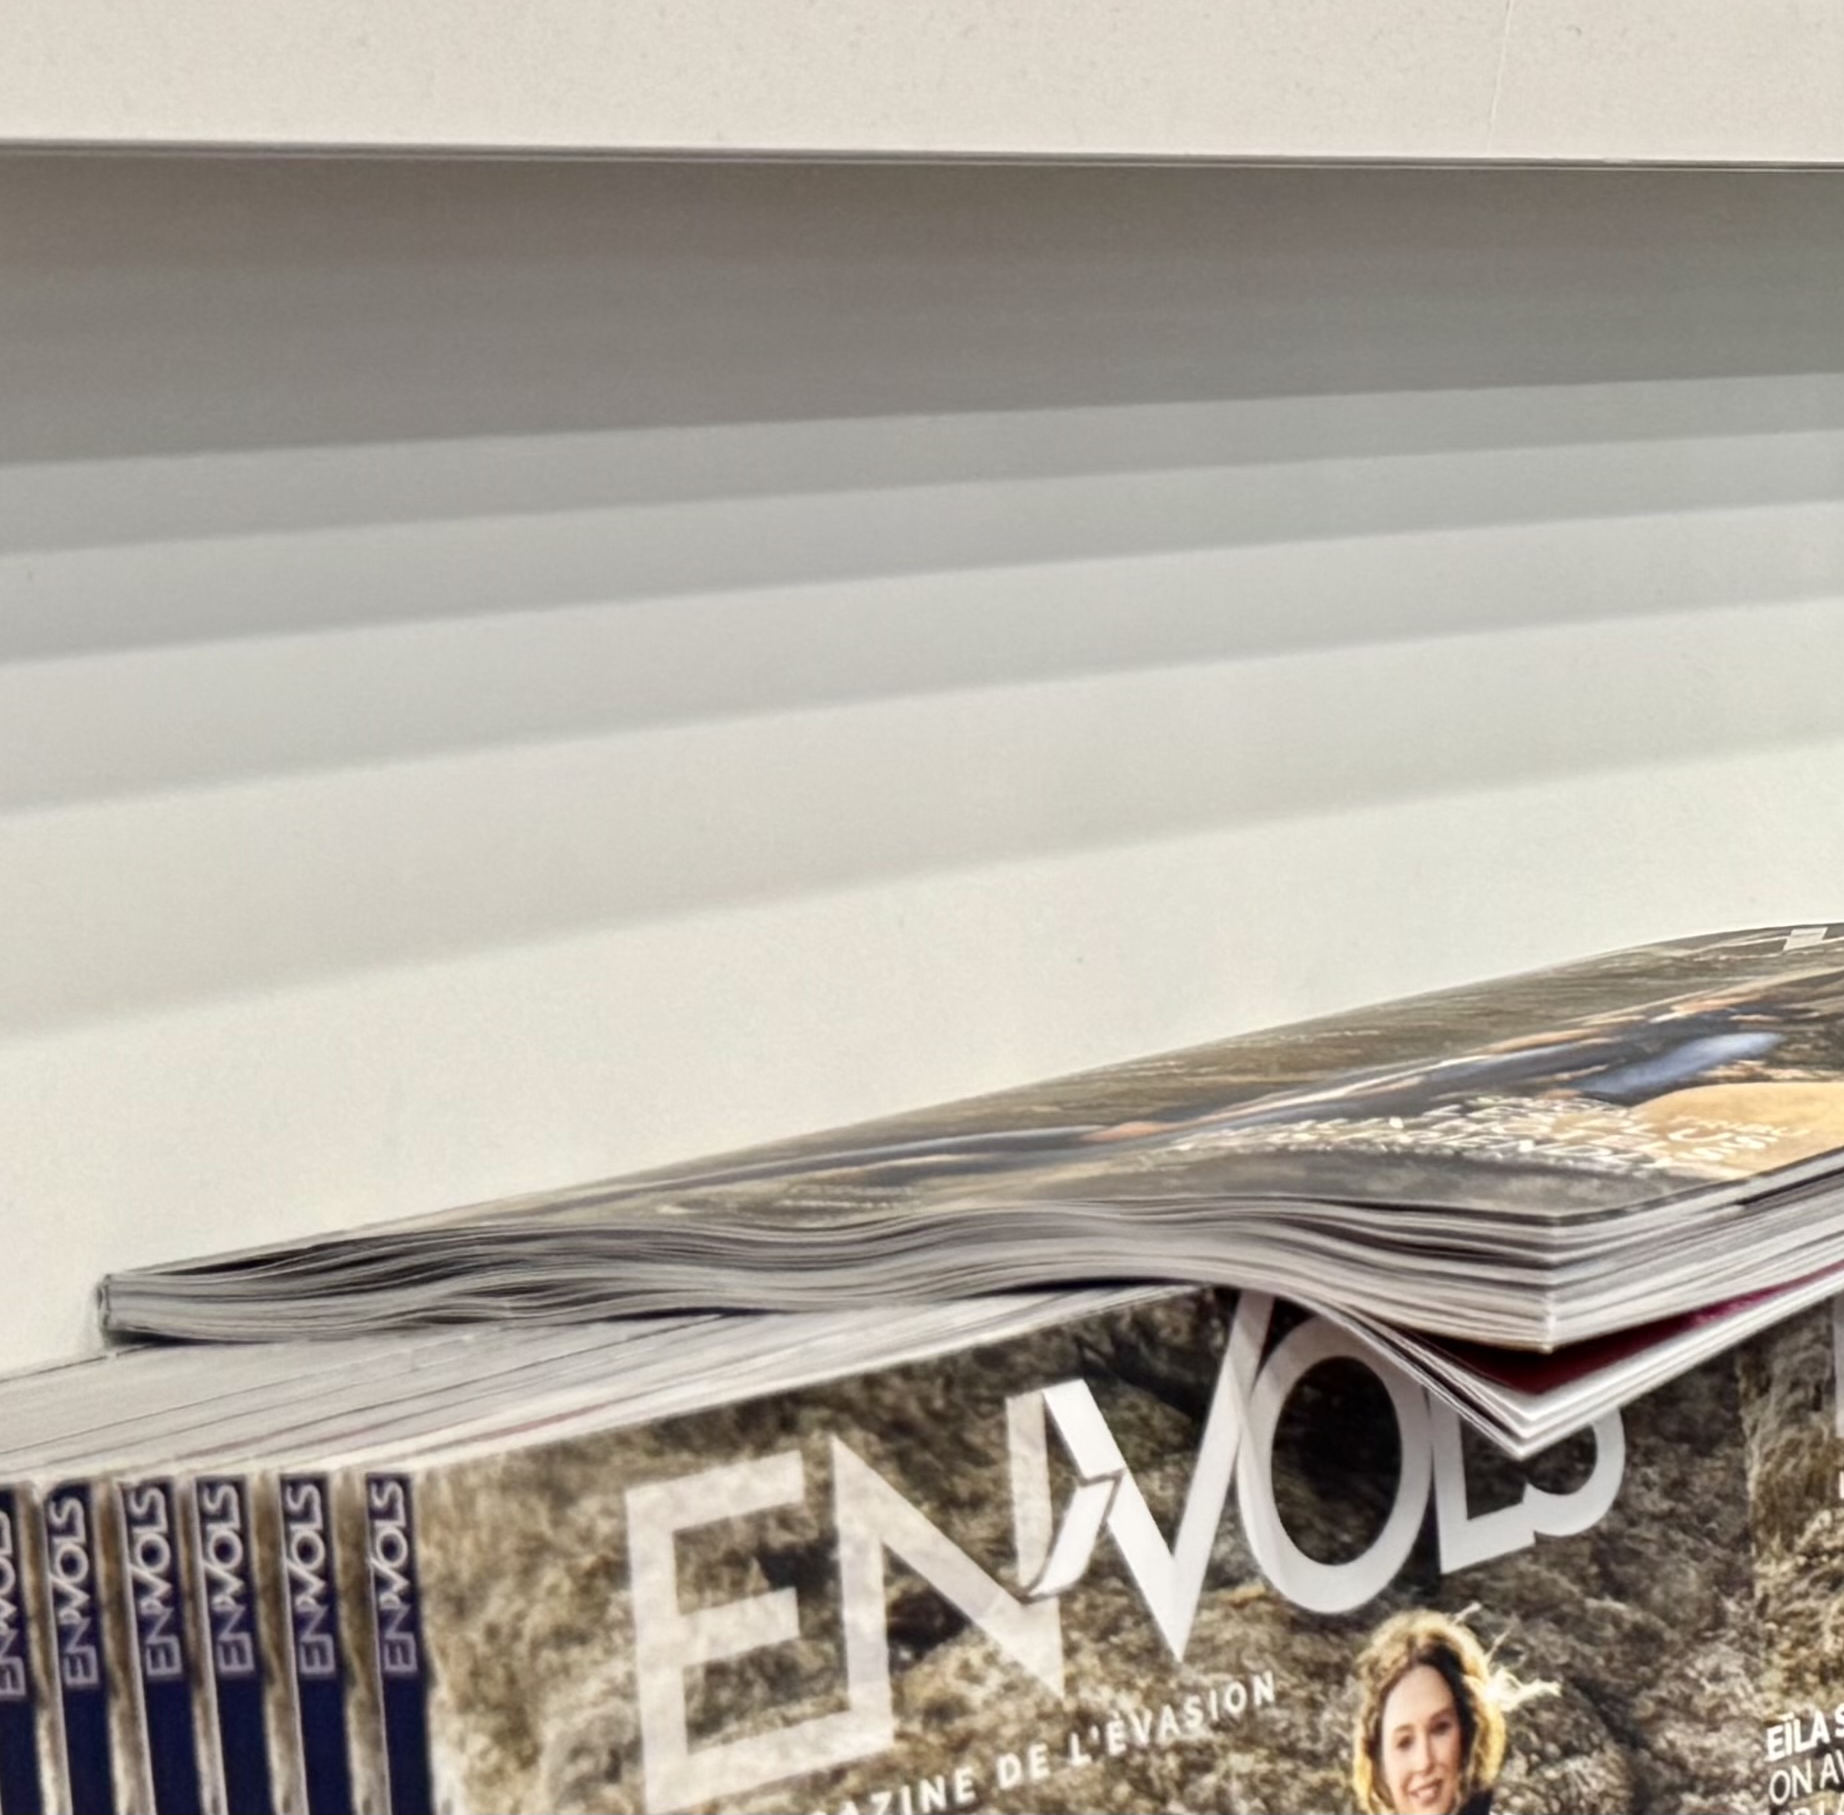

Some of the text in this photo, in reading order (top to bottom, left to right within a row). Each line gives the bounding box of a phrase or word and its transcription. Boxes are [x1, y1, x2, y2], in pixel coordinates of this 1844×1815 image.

[1766, 1711, 1830, 1761] EÏLA
[997, 1743, 1050, 1786] DE
[1769, 1759, 1812, 1805] ON
